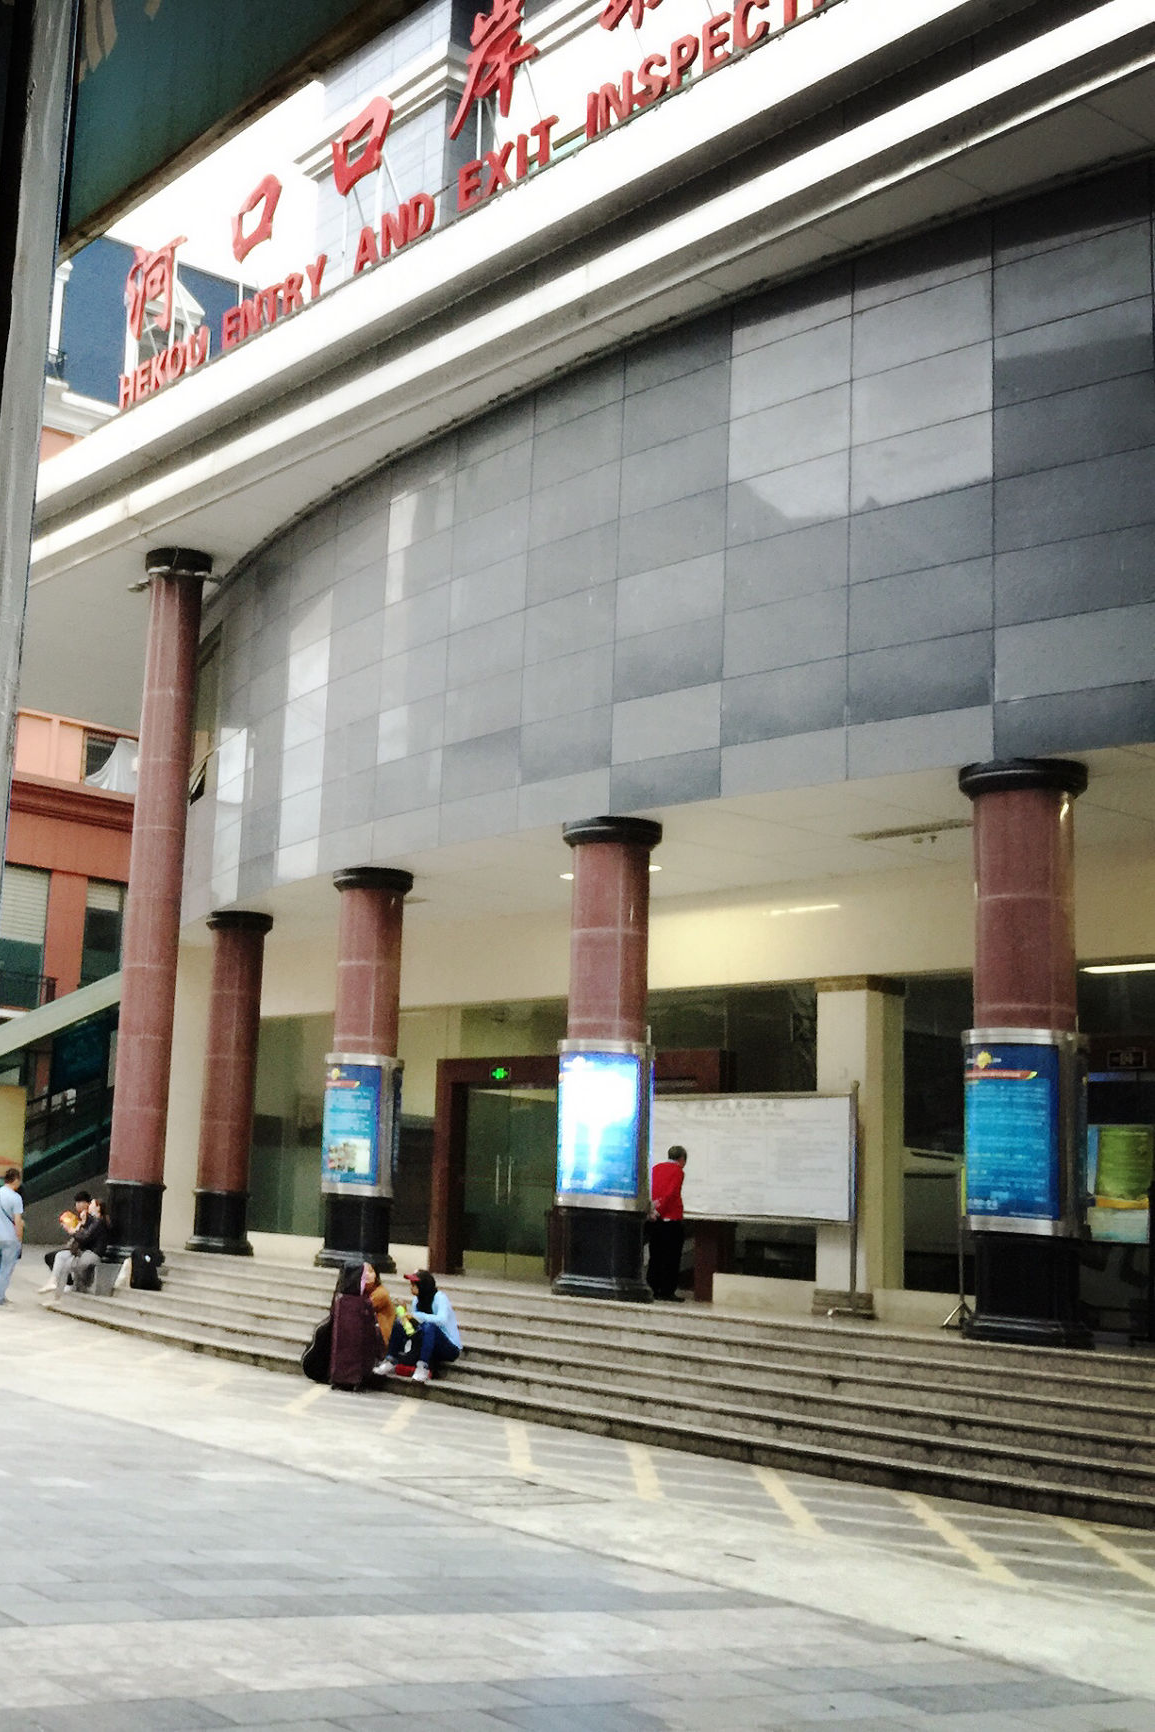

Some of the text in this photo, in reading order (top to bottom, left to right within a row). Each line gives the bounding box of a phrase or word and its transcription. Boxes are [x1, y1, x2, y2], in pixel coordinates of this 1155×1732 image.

[119, 325, 210, 411] HEKOU
[221, 253, 328, 349] ENTRY
[354, 192, 436, 274] AND
[457, 115, 559, 212] EXIT
